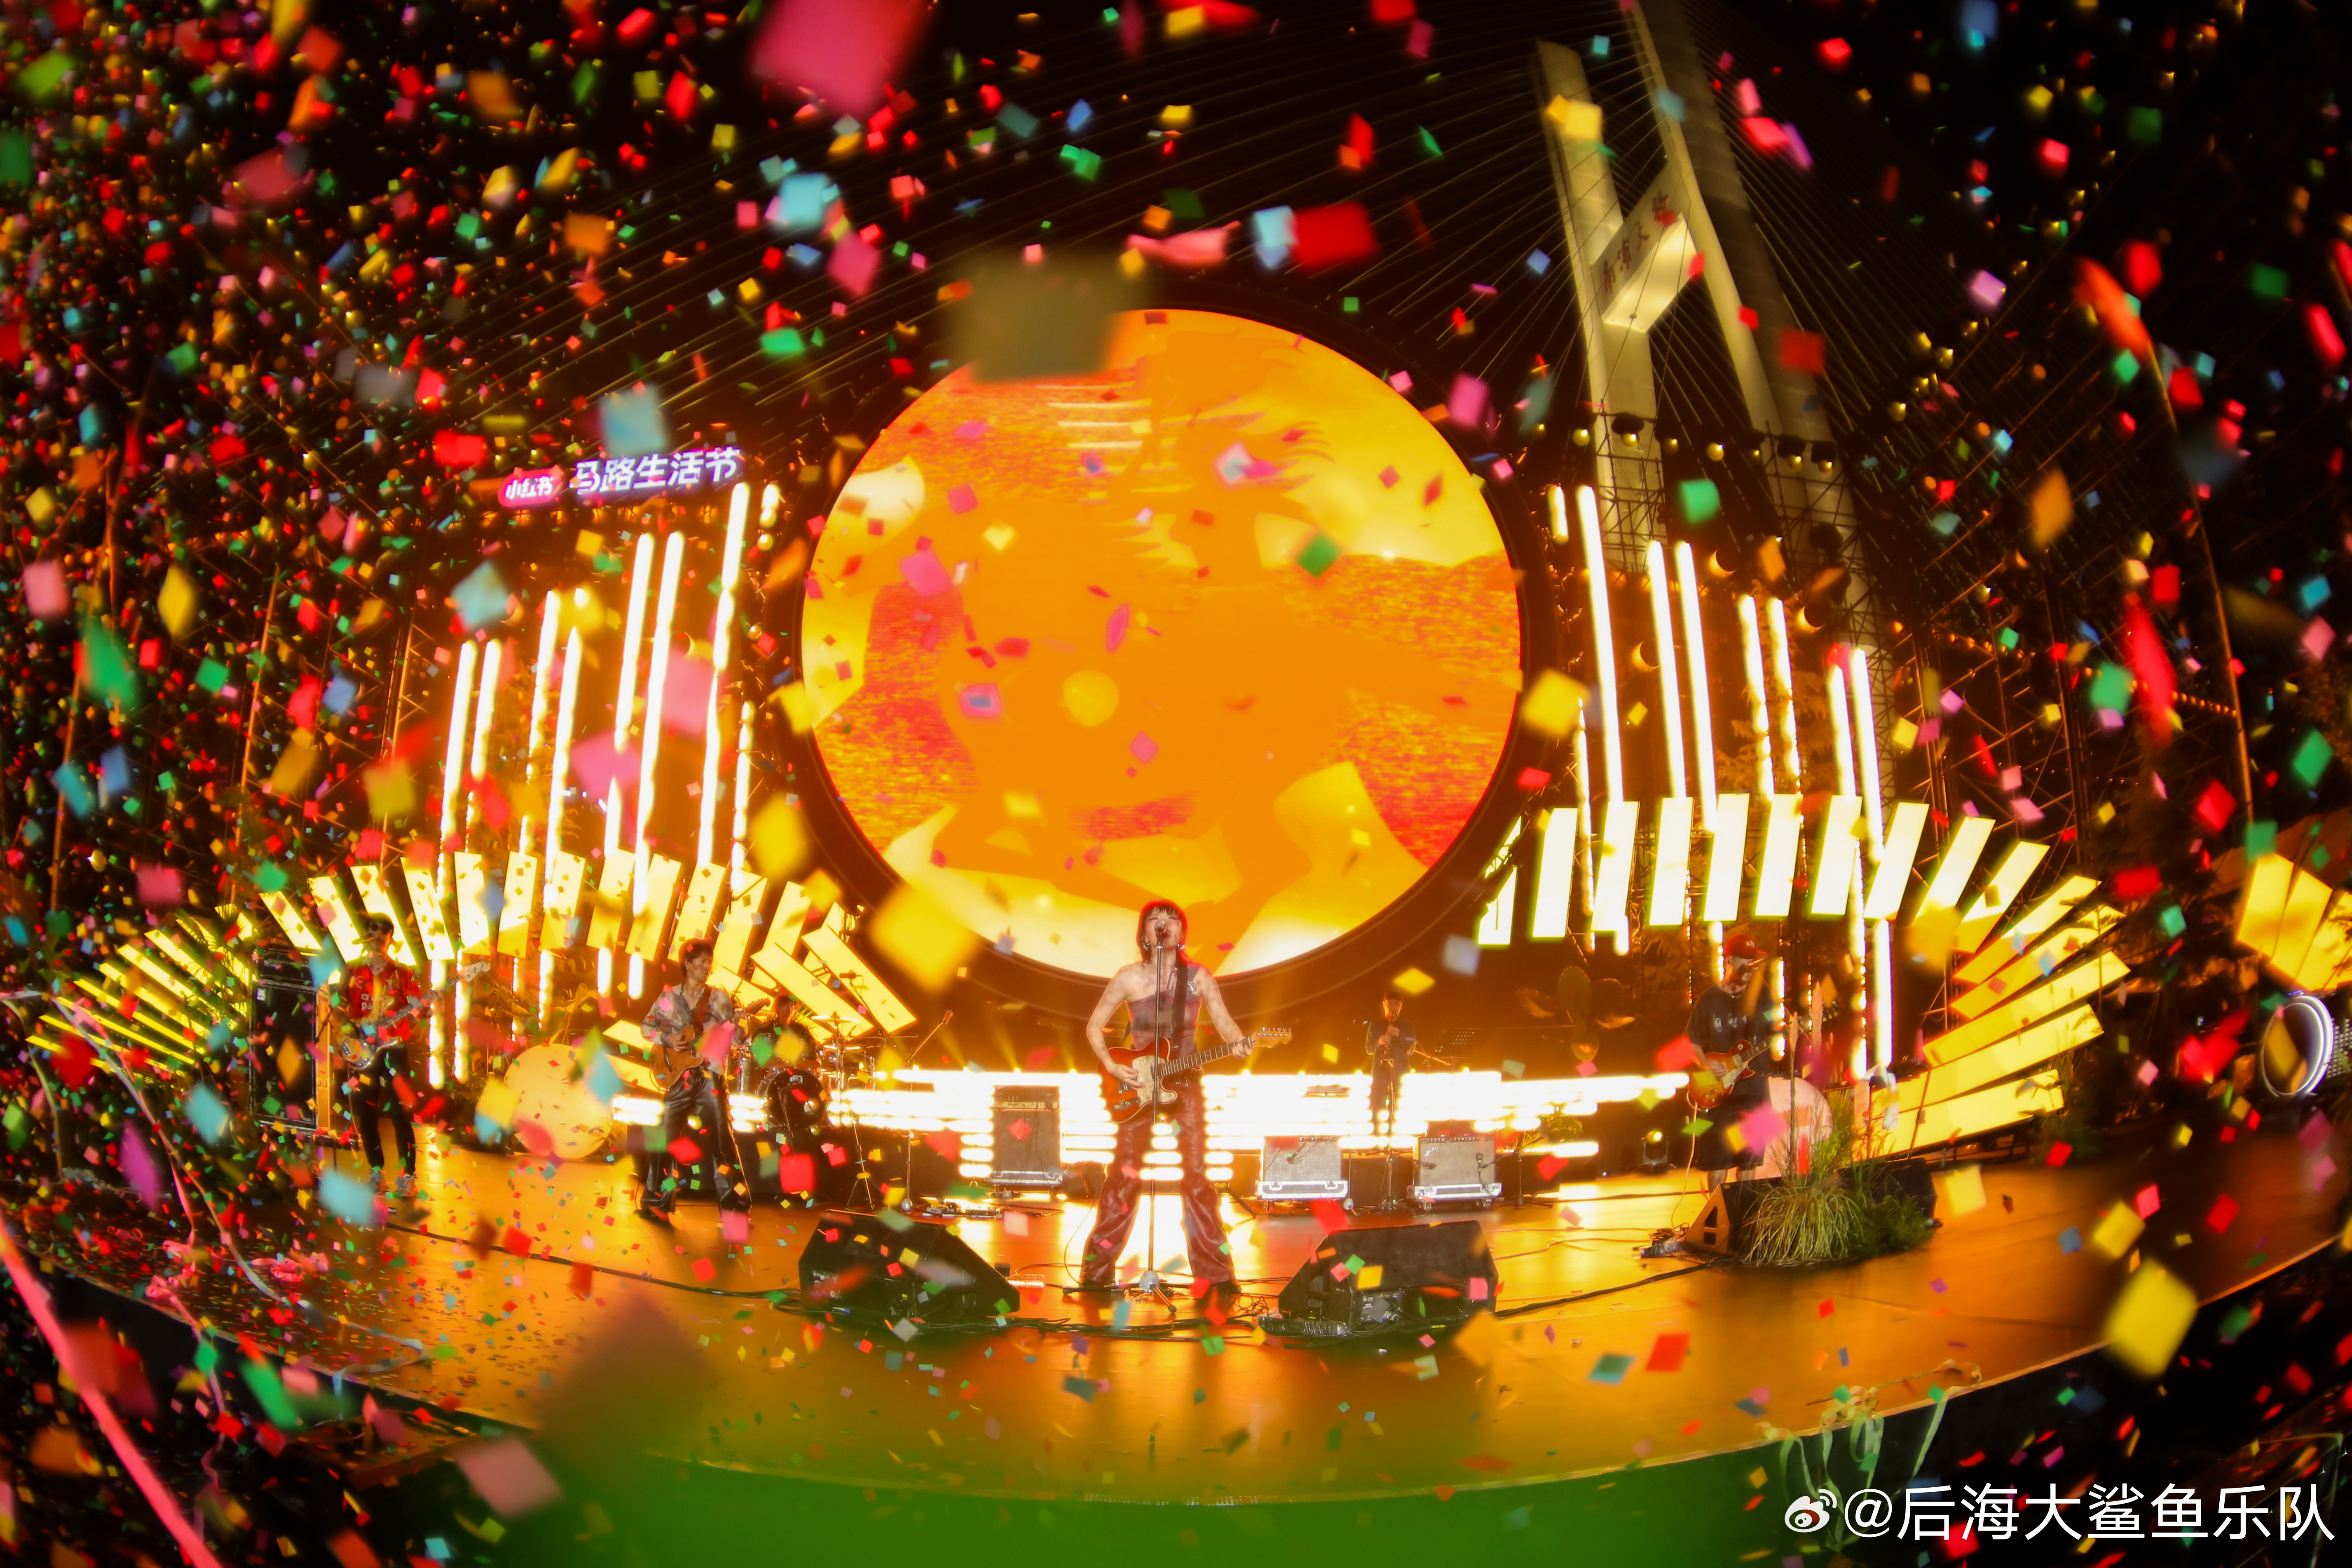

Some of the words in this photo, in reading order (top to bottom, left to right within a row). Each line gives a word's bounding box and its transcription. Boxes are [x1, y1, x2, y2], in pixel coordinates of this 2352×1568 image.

[506, 476, 553, 499] 小红书
[569, 447, 740, 495] 马路生活节
